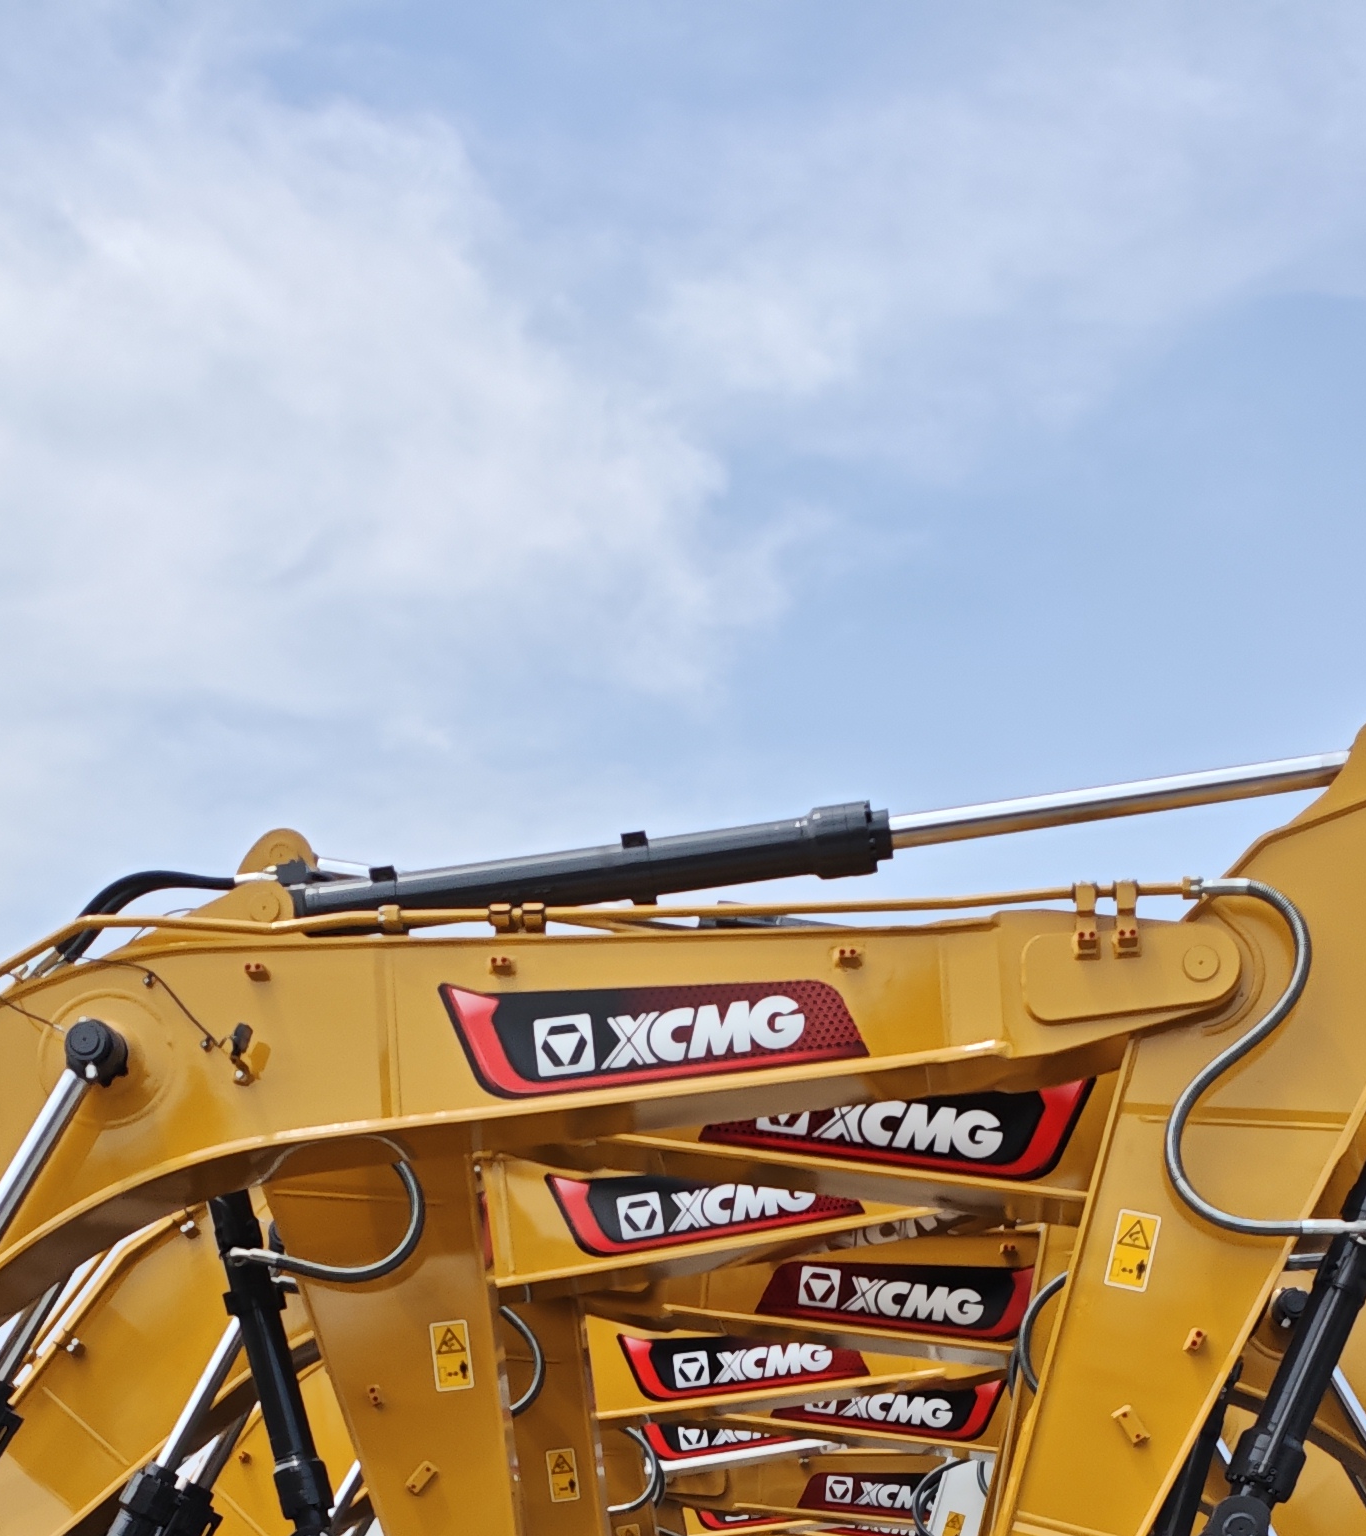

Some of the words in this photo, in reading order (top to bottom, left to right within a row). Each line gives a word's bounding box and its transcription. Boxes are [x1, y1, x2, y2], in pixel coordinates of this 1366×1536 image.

[601, 995, 805, 1069] XCMG
[812, 1100, 1004, 1159] XCMG
[841, 1276, 984, 1326] XCMG
[713, 1342, 833, 1384] XCMG
[838, 1393, 953, 1428] XCMG
[854, 1481, 935, 1511] XCM
